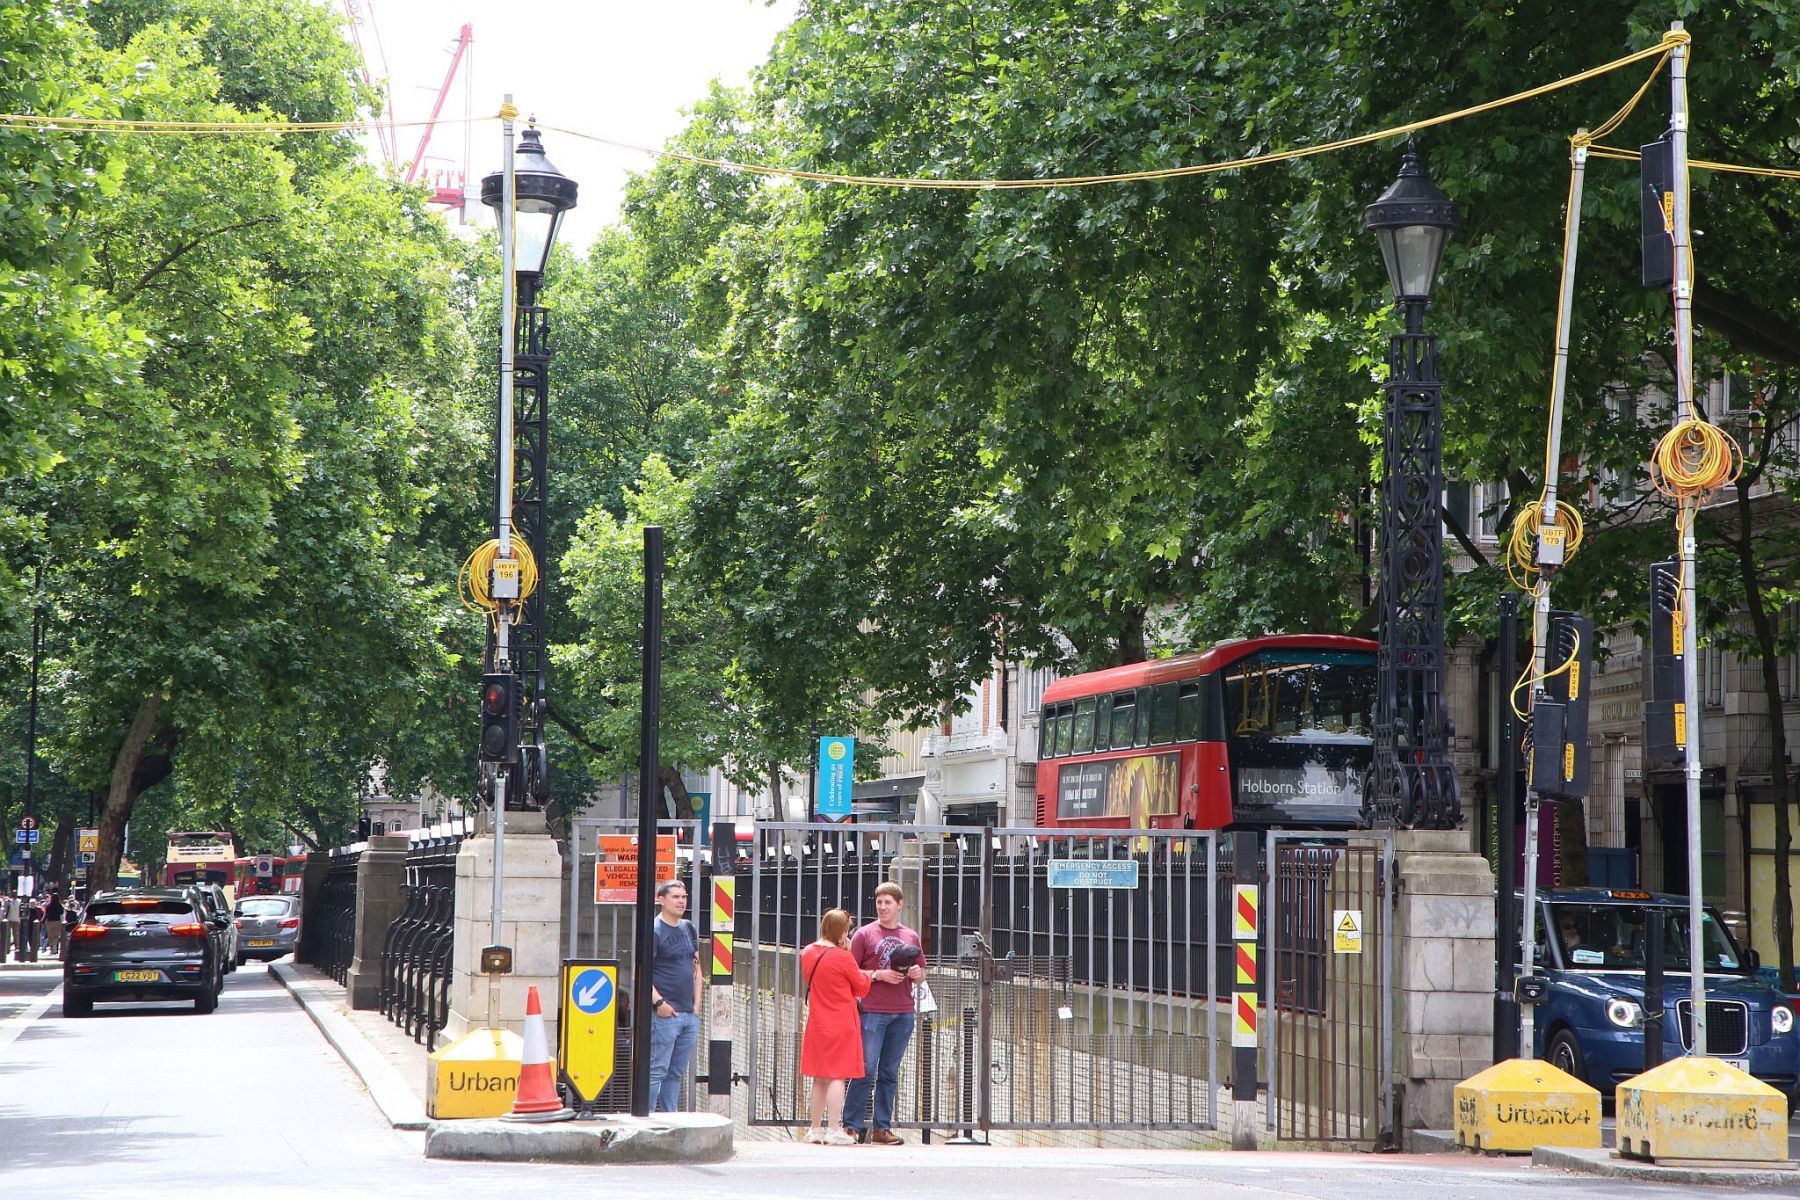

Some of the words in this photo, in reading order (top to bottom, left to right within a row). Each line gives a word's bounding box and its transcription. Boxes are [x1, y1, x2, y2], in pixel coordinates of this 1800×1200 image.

[1542, 528, 1564, 536] UBTF
[1545, 537, 1560, 545] 179
[1241, 779, 1294, 794] Holborn
[1297, 780, 1341, 795] Station
[1055, 862, 1100, 870] EMERGENCY
[1102, 862, 1132, 870] ACCESS
[120, 972, 141, 980] LG22
[449, 1072, 520, 1092] Urban
